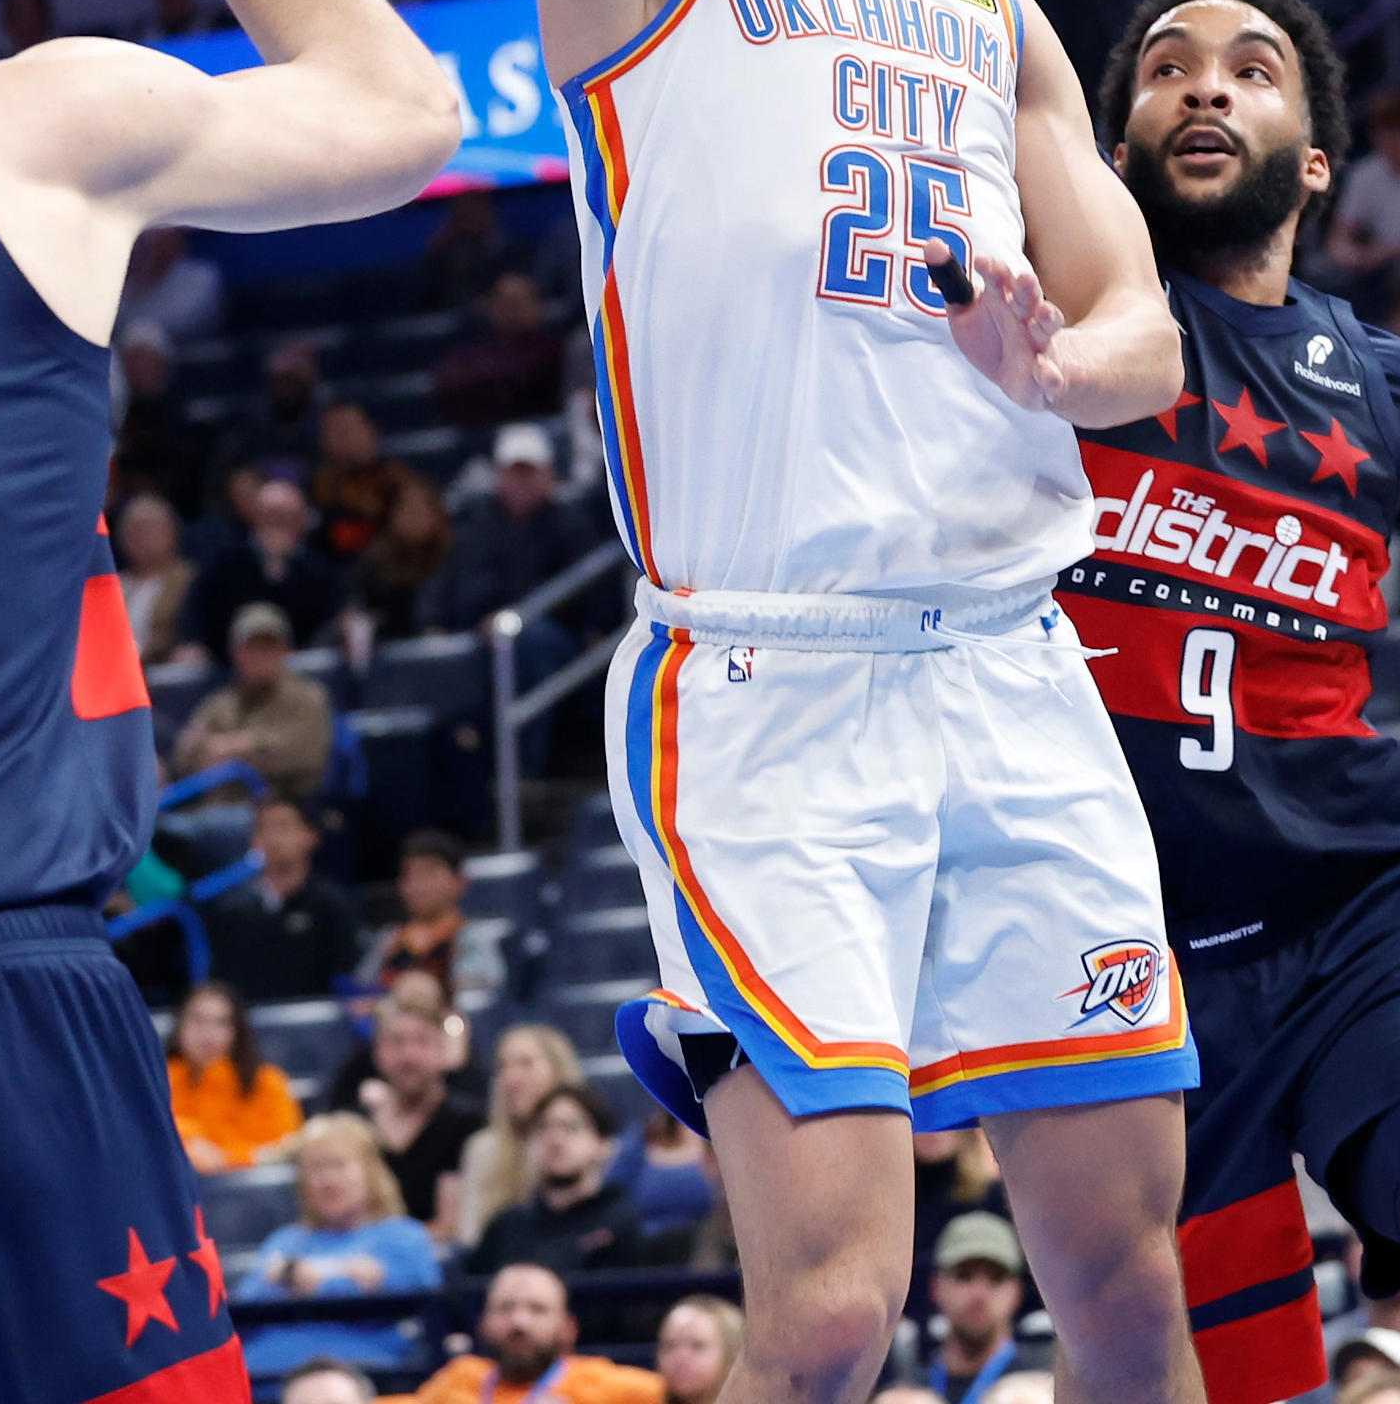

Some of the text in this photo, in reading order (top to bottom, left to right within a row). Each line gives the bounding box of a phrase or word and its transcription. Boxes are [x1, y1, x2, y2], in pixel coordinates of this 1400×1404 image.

[833, 54, 968, 156] CITY
[816, 144, 974, 317] 25
[1294, 360, 1361, 397] Robinhood
[1090, 468, 1349, 608] district
[1171, 487, 1216, 515] THE
[1071, 568, 1107, 587] OF
[1177, 625, 1237, 773] 9
[1082, 953, 1151, 1012] OKC
